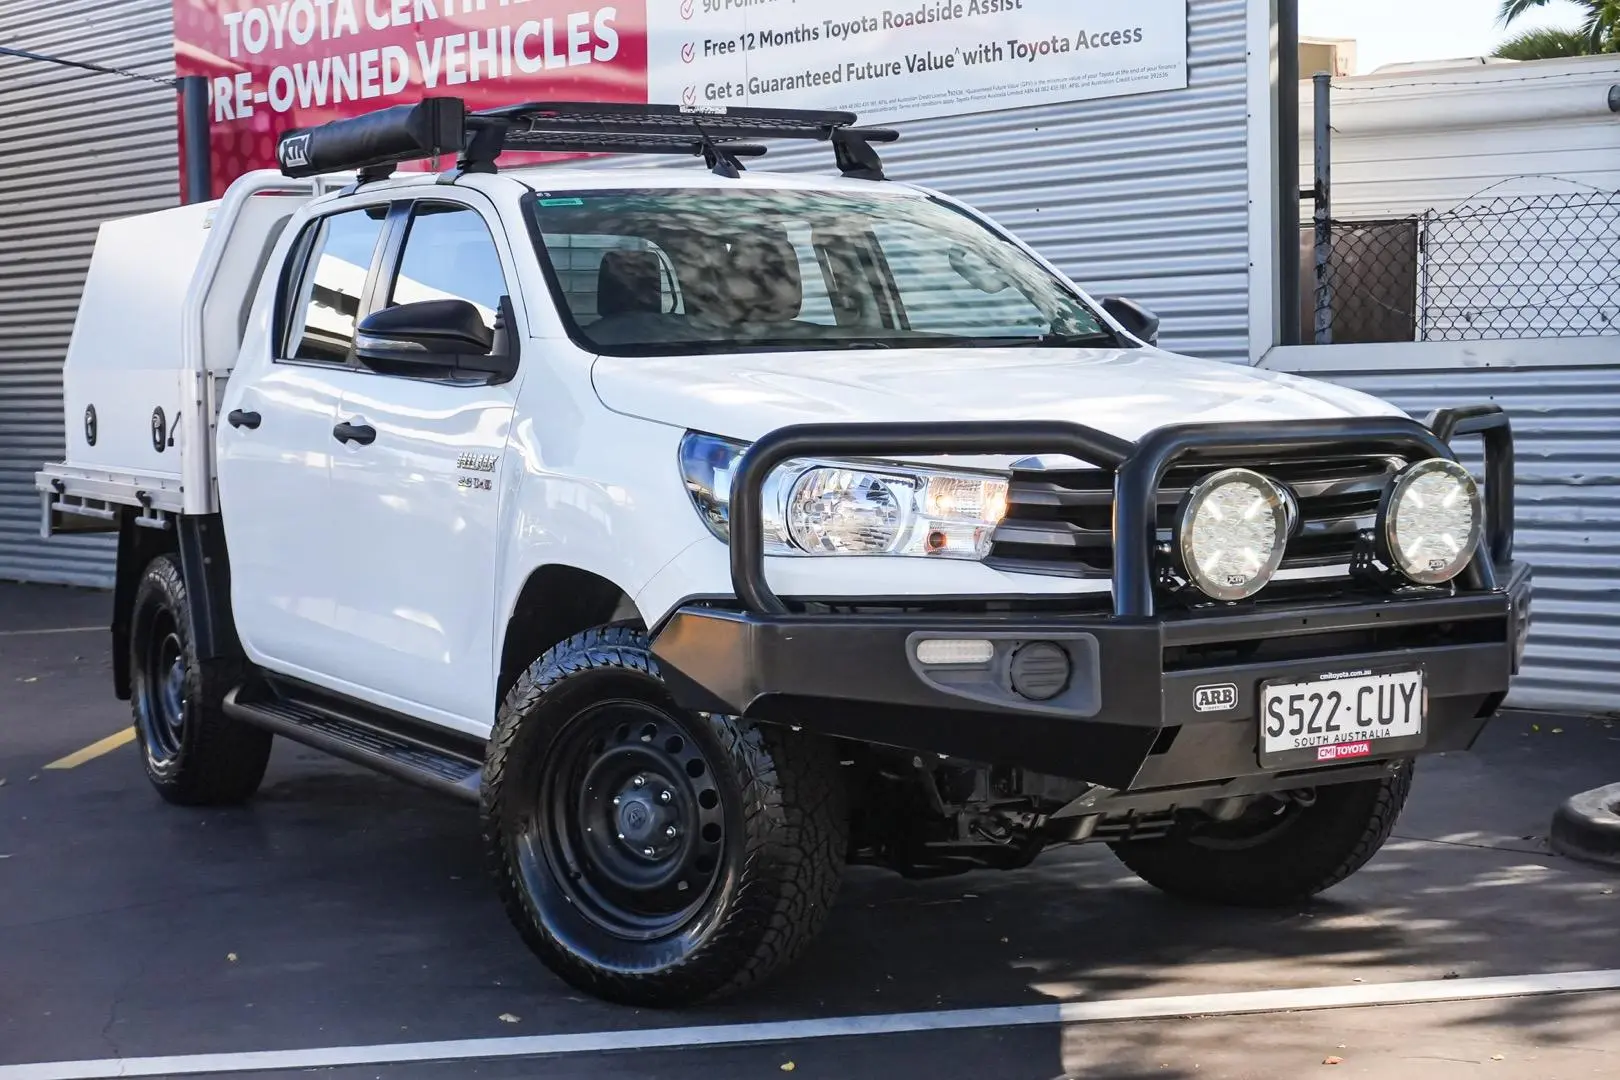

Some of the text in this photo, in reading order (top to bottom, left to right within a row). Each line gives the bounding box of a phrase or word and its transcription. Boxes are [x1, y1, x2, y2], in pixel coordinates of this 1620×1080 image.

[223, 0, 358, 57] TOYOTA
[704, 40, 736, 57] Free
[739, 33, 756, 51] 12
[760, 24, 819, 48] Months
[823, 16, 878, 40] Toyota
[882, 0, 963, 29] Roadside
[416, 7, 619, 88] VEHICLES
[705, 81, 733, 100] Get
[736, 84, 744, 96] a
[749, 64, 842, 95] Guaranteed
[847, 61, 901, 82] Future
[963, 42, 1003, 65] with
[1007, 35, 1070, 62] Toyota
[1075, 27, 1143, 51] Access
[1319, 669, 1372, 680] cmitoyota.com.au
[1199, 689, 1233, 706] ARB
[1294, 729, 1391, 747] SOUTH AUSTRALIA
[1319, 743, 1369, 759] CMI TOYOTA
